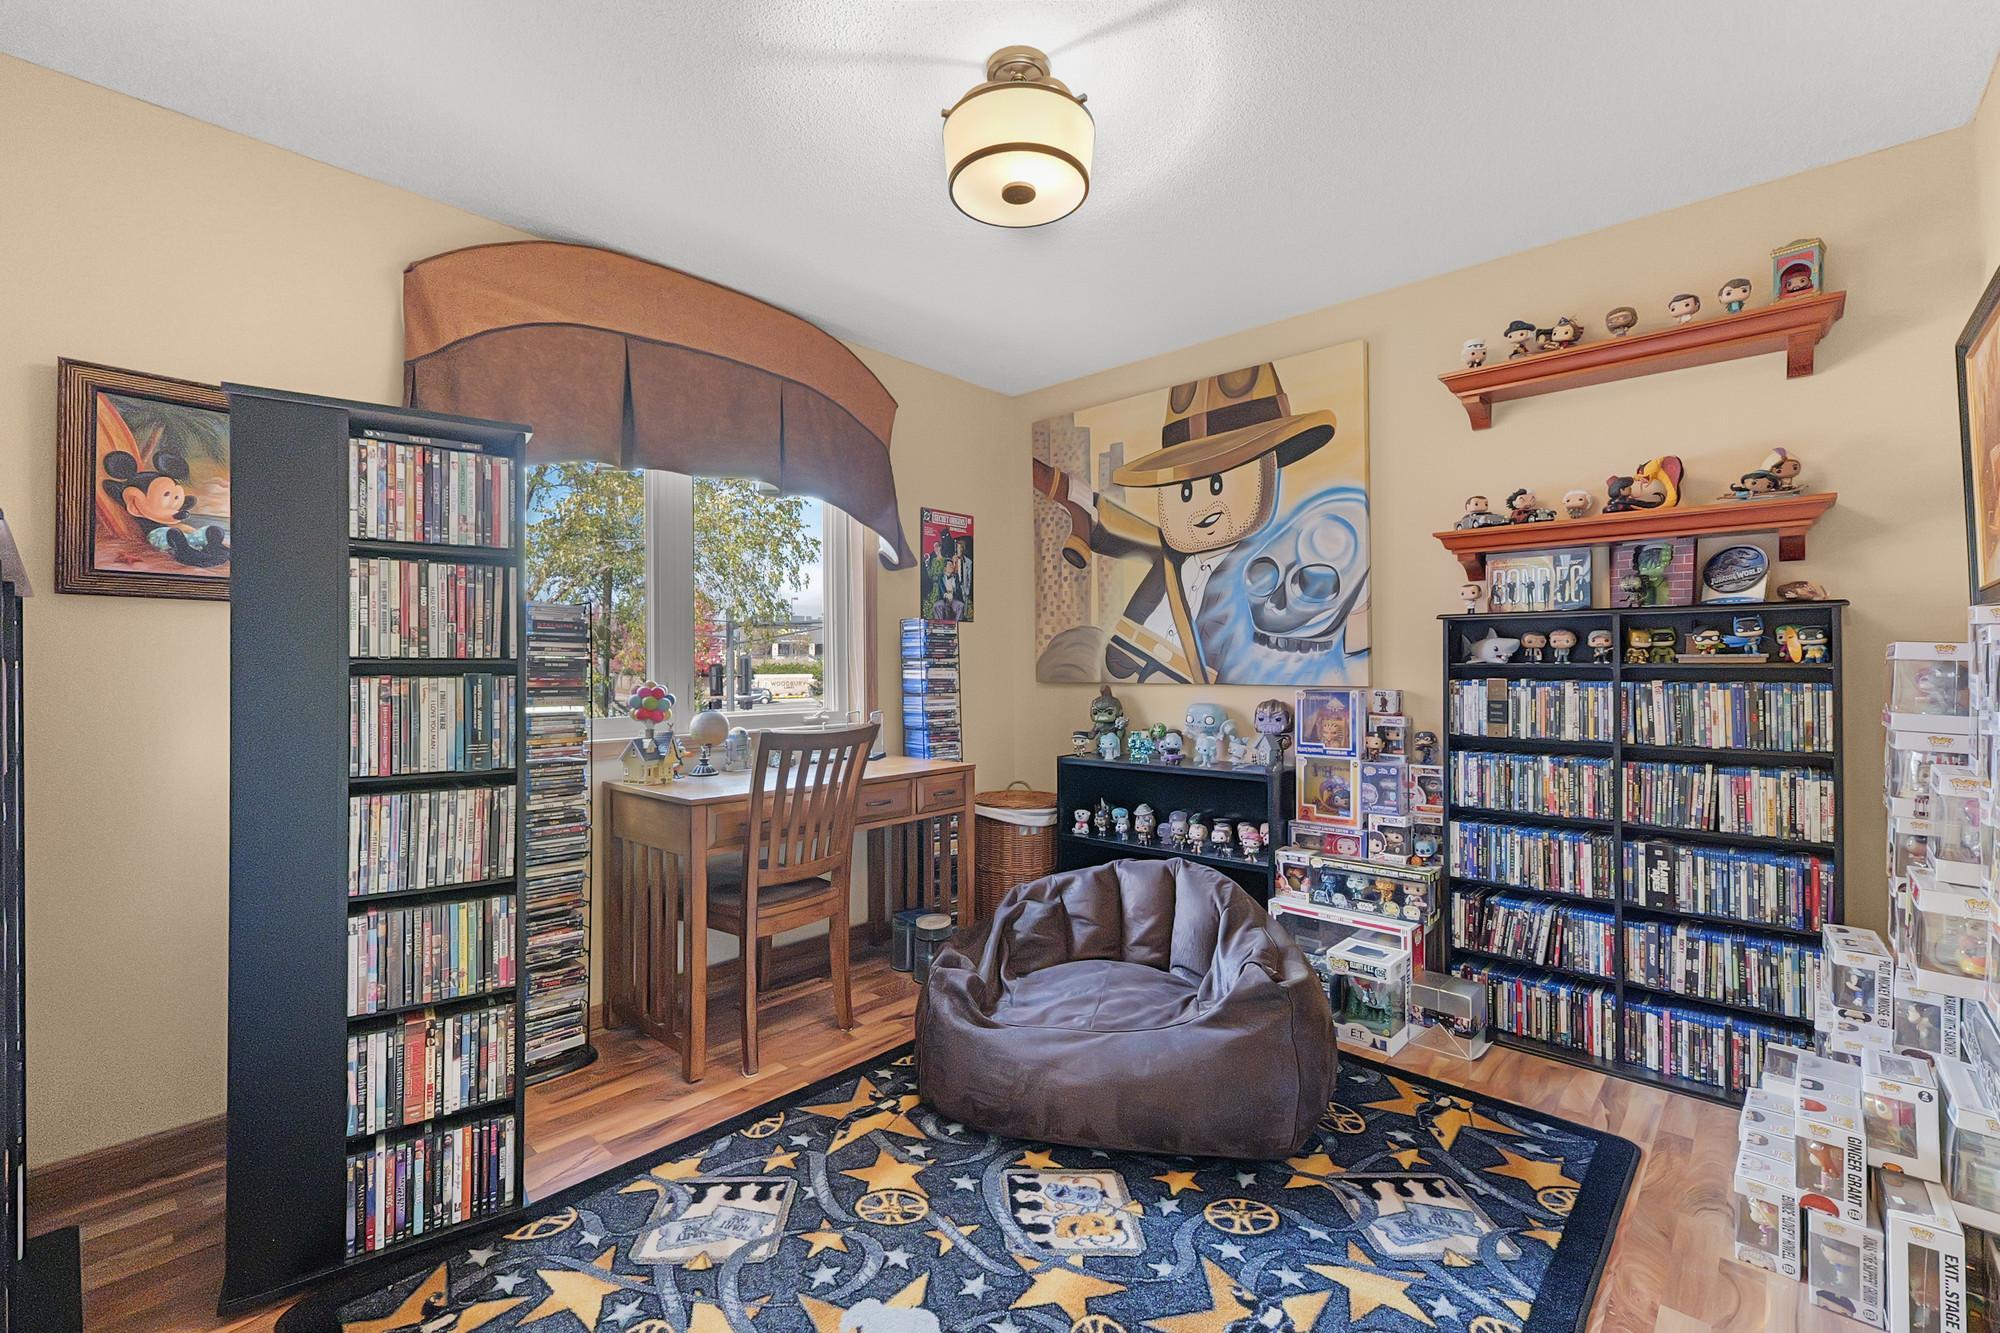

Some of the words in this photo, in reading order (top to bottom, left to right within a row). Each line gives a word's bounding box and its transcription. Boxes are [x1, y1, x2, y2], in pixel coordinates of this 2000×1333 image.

[933, 513, 949, 524] SECRET
[1492, 567, 1552, 606] BOND
[1711, 573, 1738, 586] JURASSIC
[1737, 567, 1763, 578] WORLD
[1650, 868, 1660, 892] APES
[1658, 861, 1671, 895] PLANET
[1878, 960, 1891, 976] PILOT
[1878, 976, 1891, 996] MICKEY
[1878, 997, 1891, 1016] MOUSE
[1350, 1028, 1364, 1040] E.T.
[1848, 1136, 1862, 1172] GINGER
[1848, 1174, 1862, 1207] GRANT
